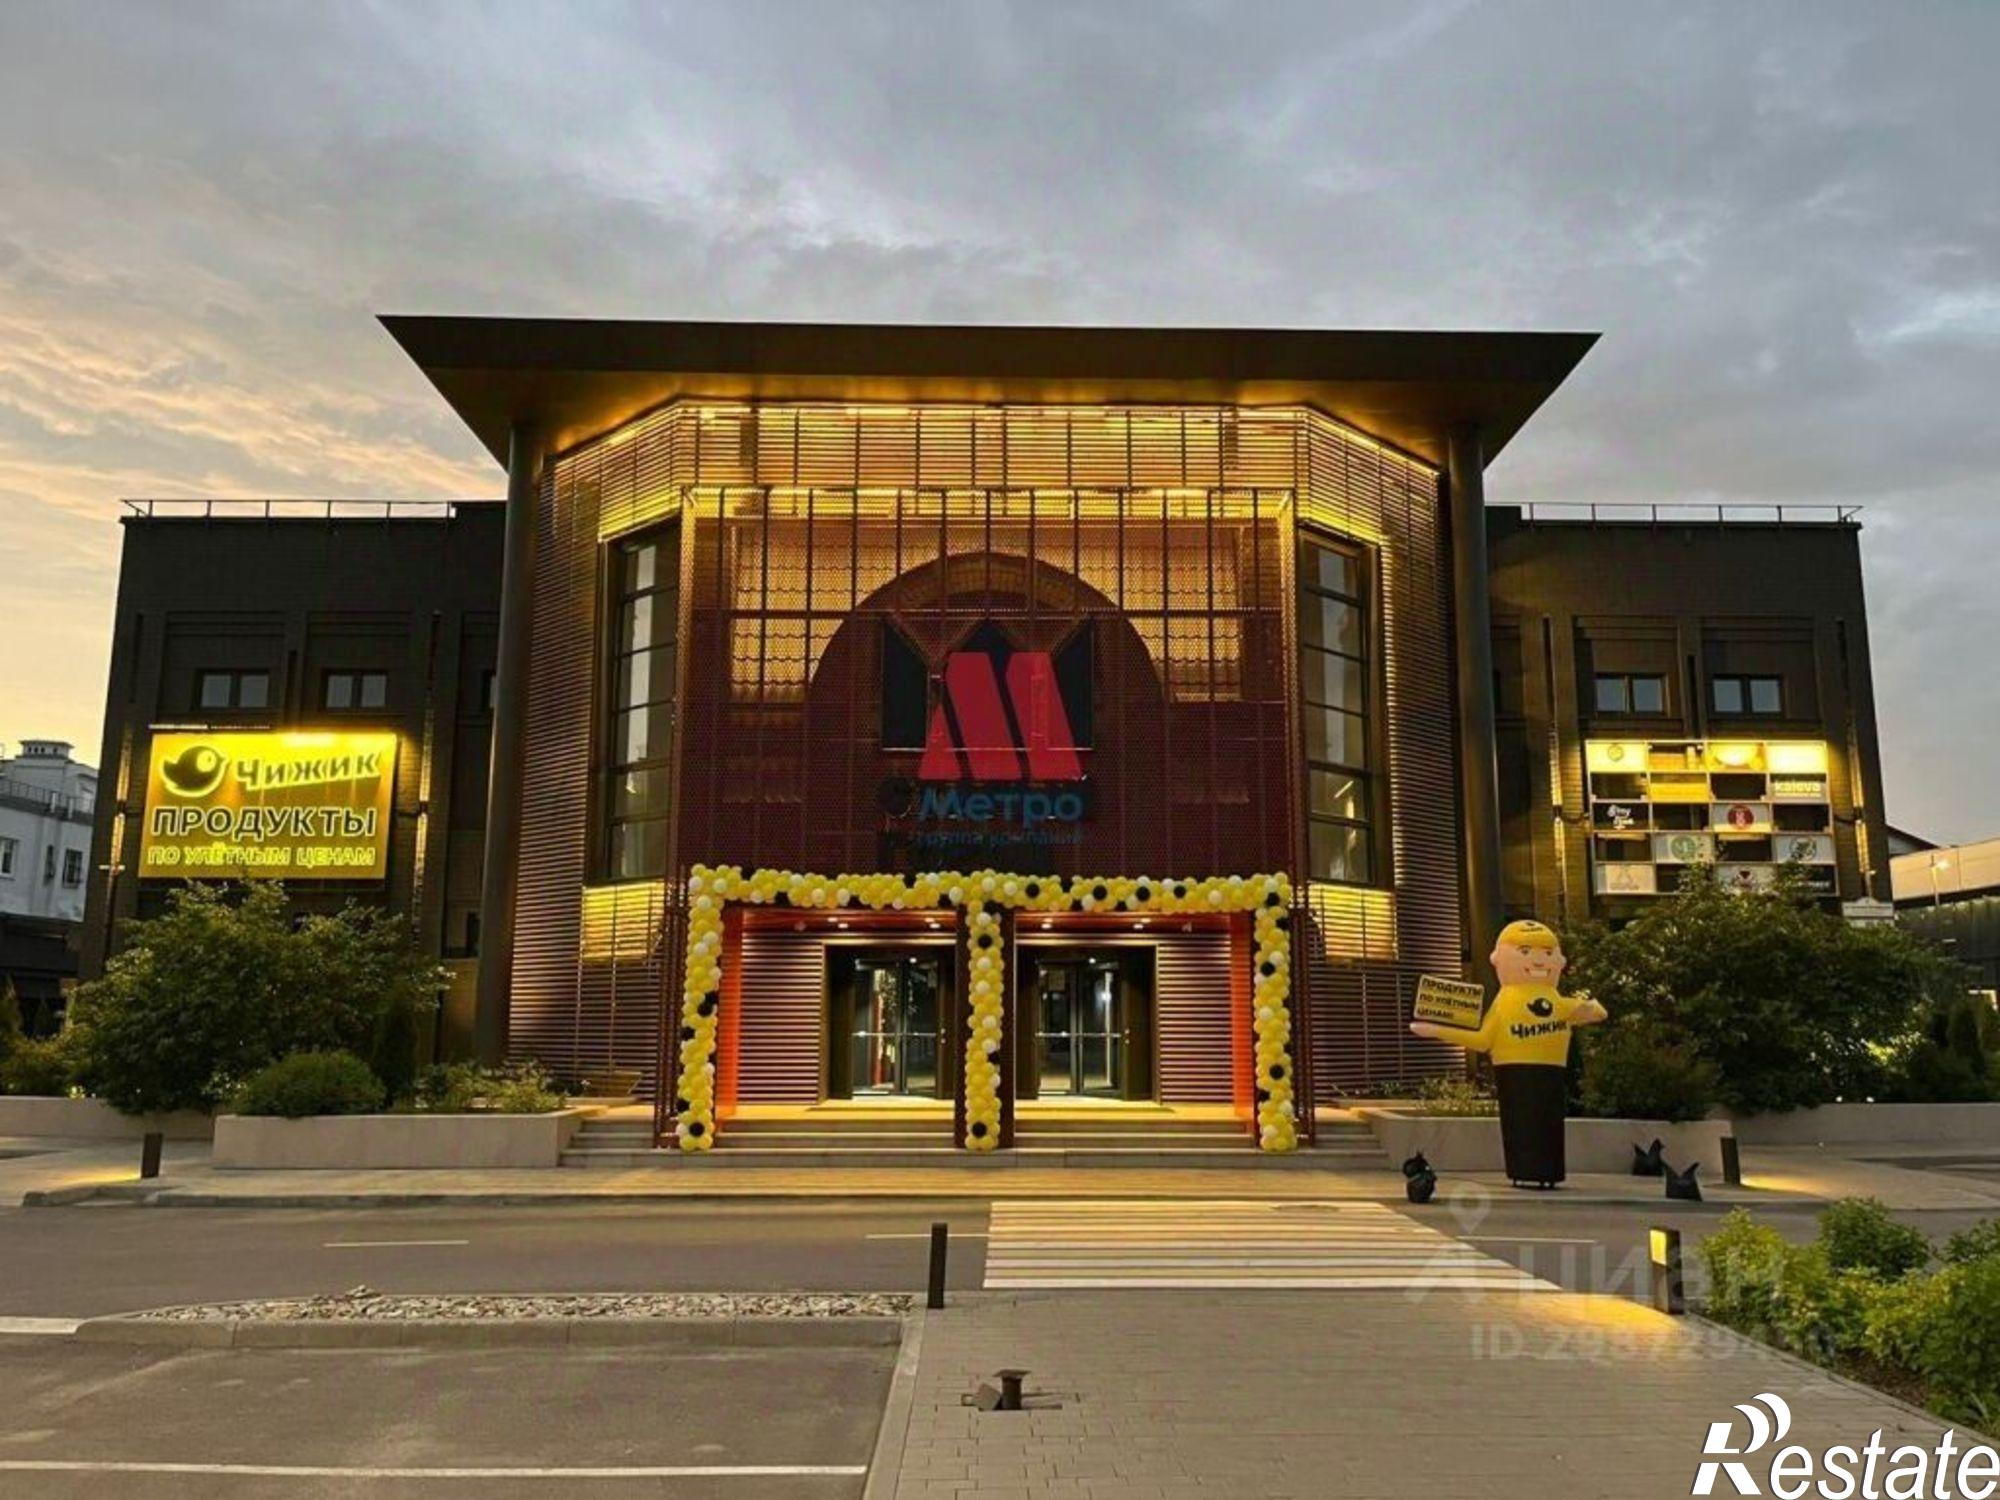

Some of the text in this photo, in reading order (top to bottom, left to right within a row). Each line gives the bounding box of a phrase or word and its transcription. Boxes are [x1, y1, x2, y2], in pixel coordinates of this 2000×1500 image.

[235, 752, 382, 792] Чижик
[151, 806, 378, 842] ПРОДУКТЫ
[917, 786, 1084, 829] Метро
[147, 841, 376, 869] ПО УЛЁТНЫМ ЦЕНАМ
